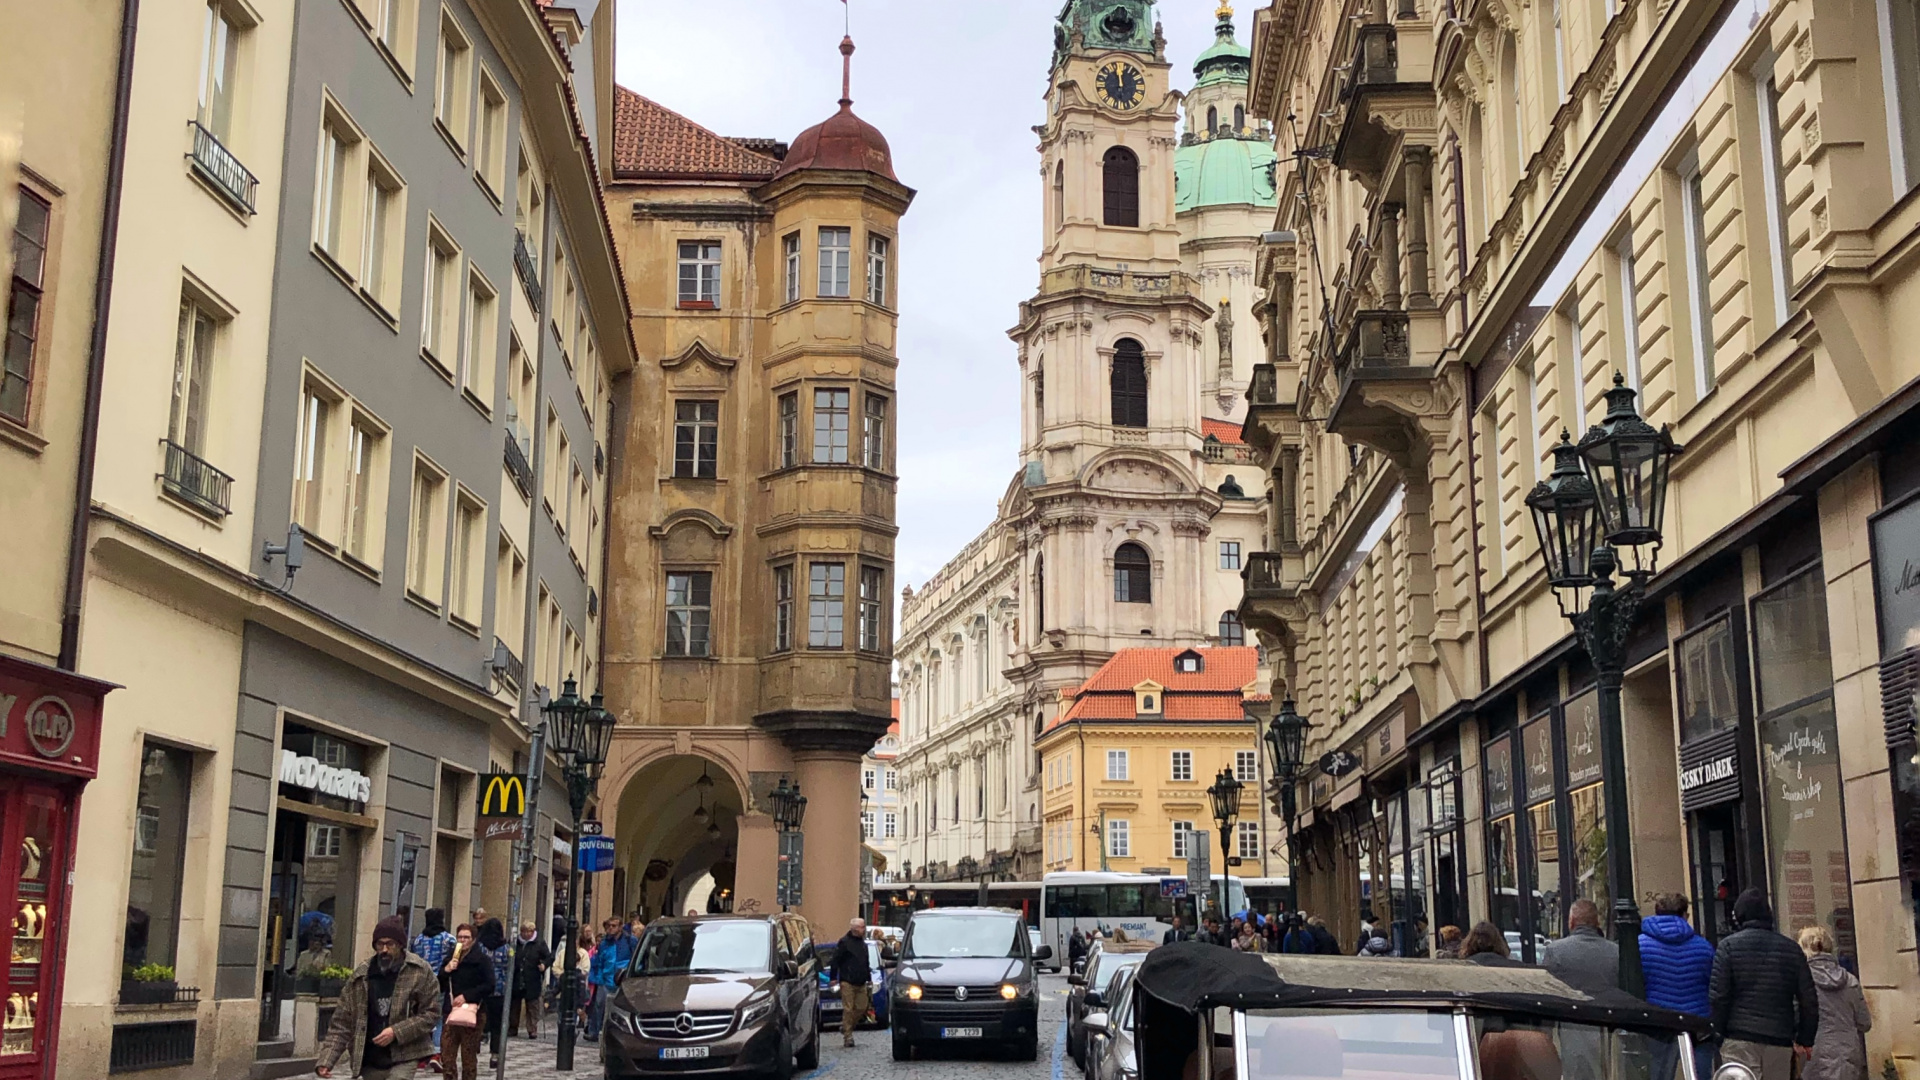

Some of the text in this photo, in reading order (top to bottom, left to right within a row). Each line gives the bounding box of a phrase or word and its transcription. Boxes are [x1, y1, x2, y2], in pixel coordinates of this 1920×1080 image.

[279, 749, 371, 803] McDonald's
[1704, 757, 1734, 784] DÁREK
[583, 823, 593, 833] WC
[579, 840, 615, 850] SOUVENIRS
[665, 1048, 706, 1059] 6AT 3136
